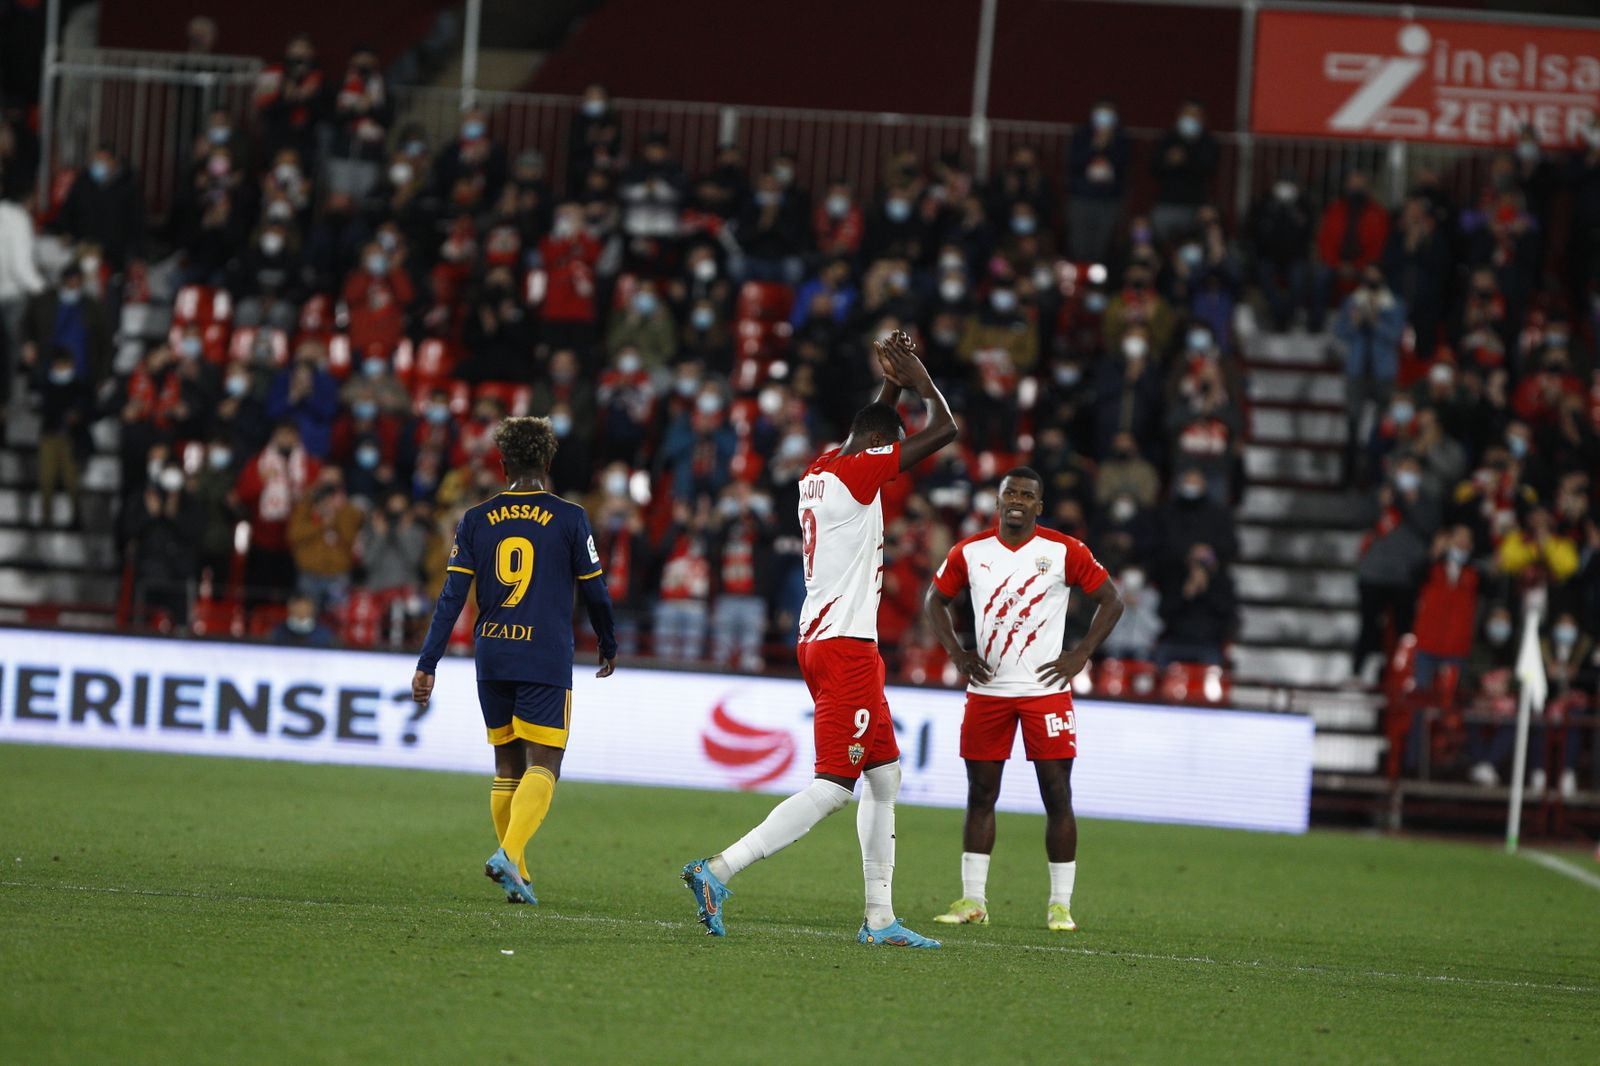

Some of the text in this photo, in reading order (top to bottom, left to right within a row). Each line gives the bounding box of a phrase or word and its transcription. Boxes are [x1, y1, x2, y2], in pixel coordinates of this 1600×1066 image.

[486, 504, 554, 527] HASSAN
[801, 508, 817, 581] 9
[495, 536, 534, 608] 9
[480, 621, 534, 641] IZADI
[0, 665, 431, 744] ERIENSE?
[852, 708, 870, 739] 9
